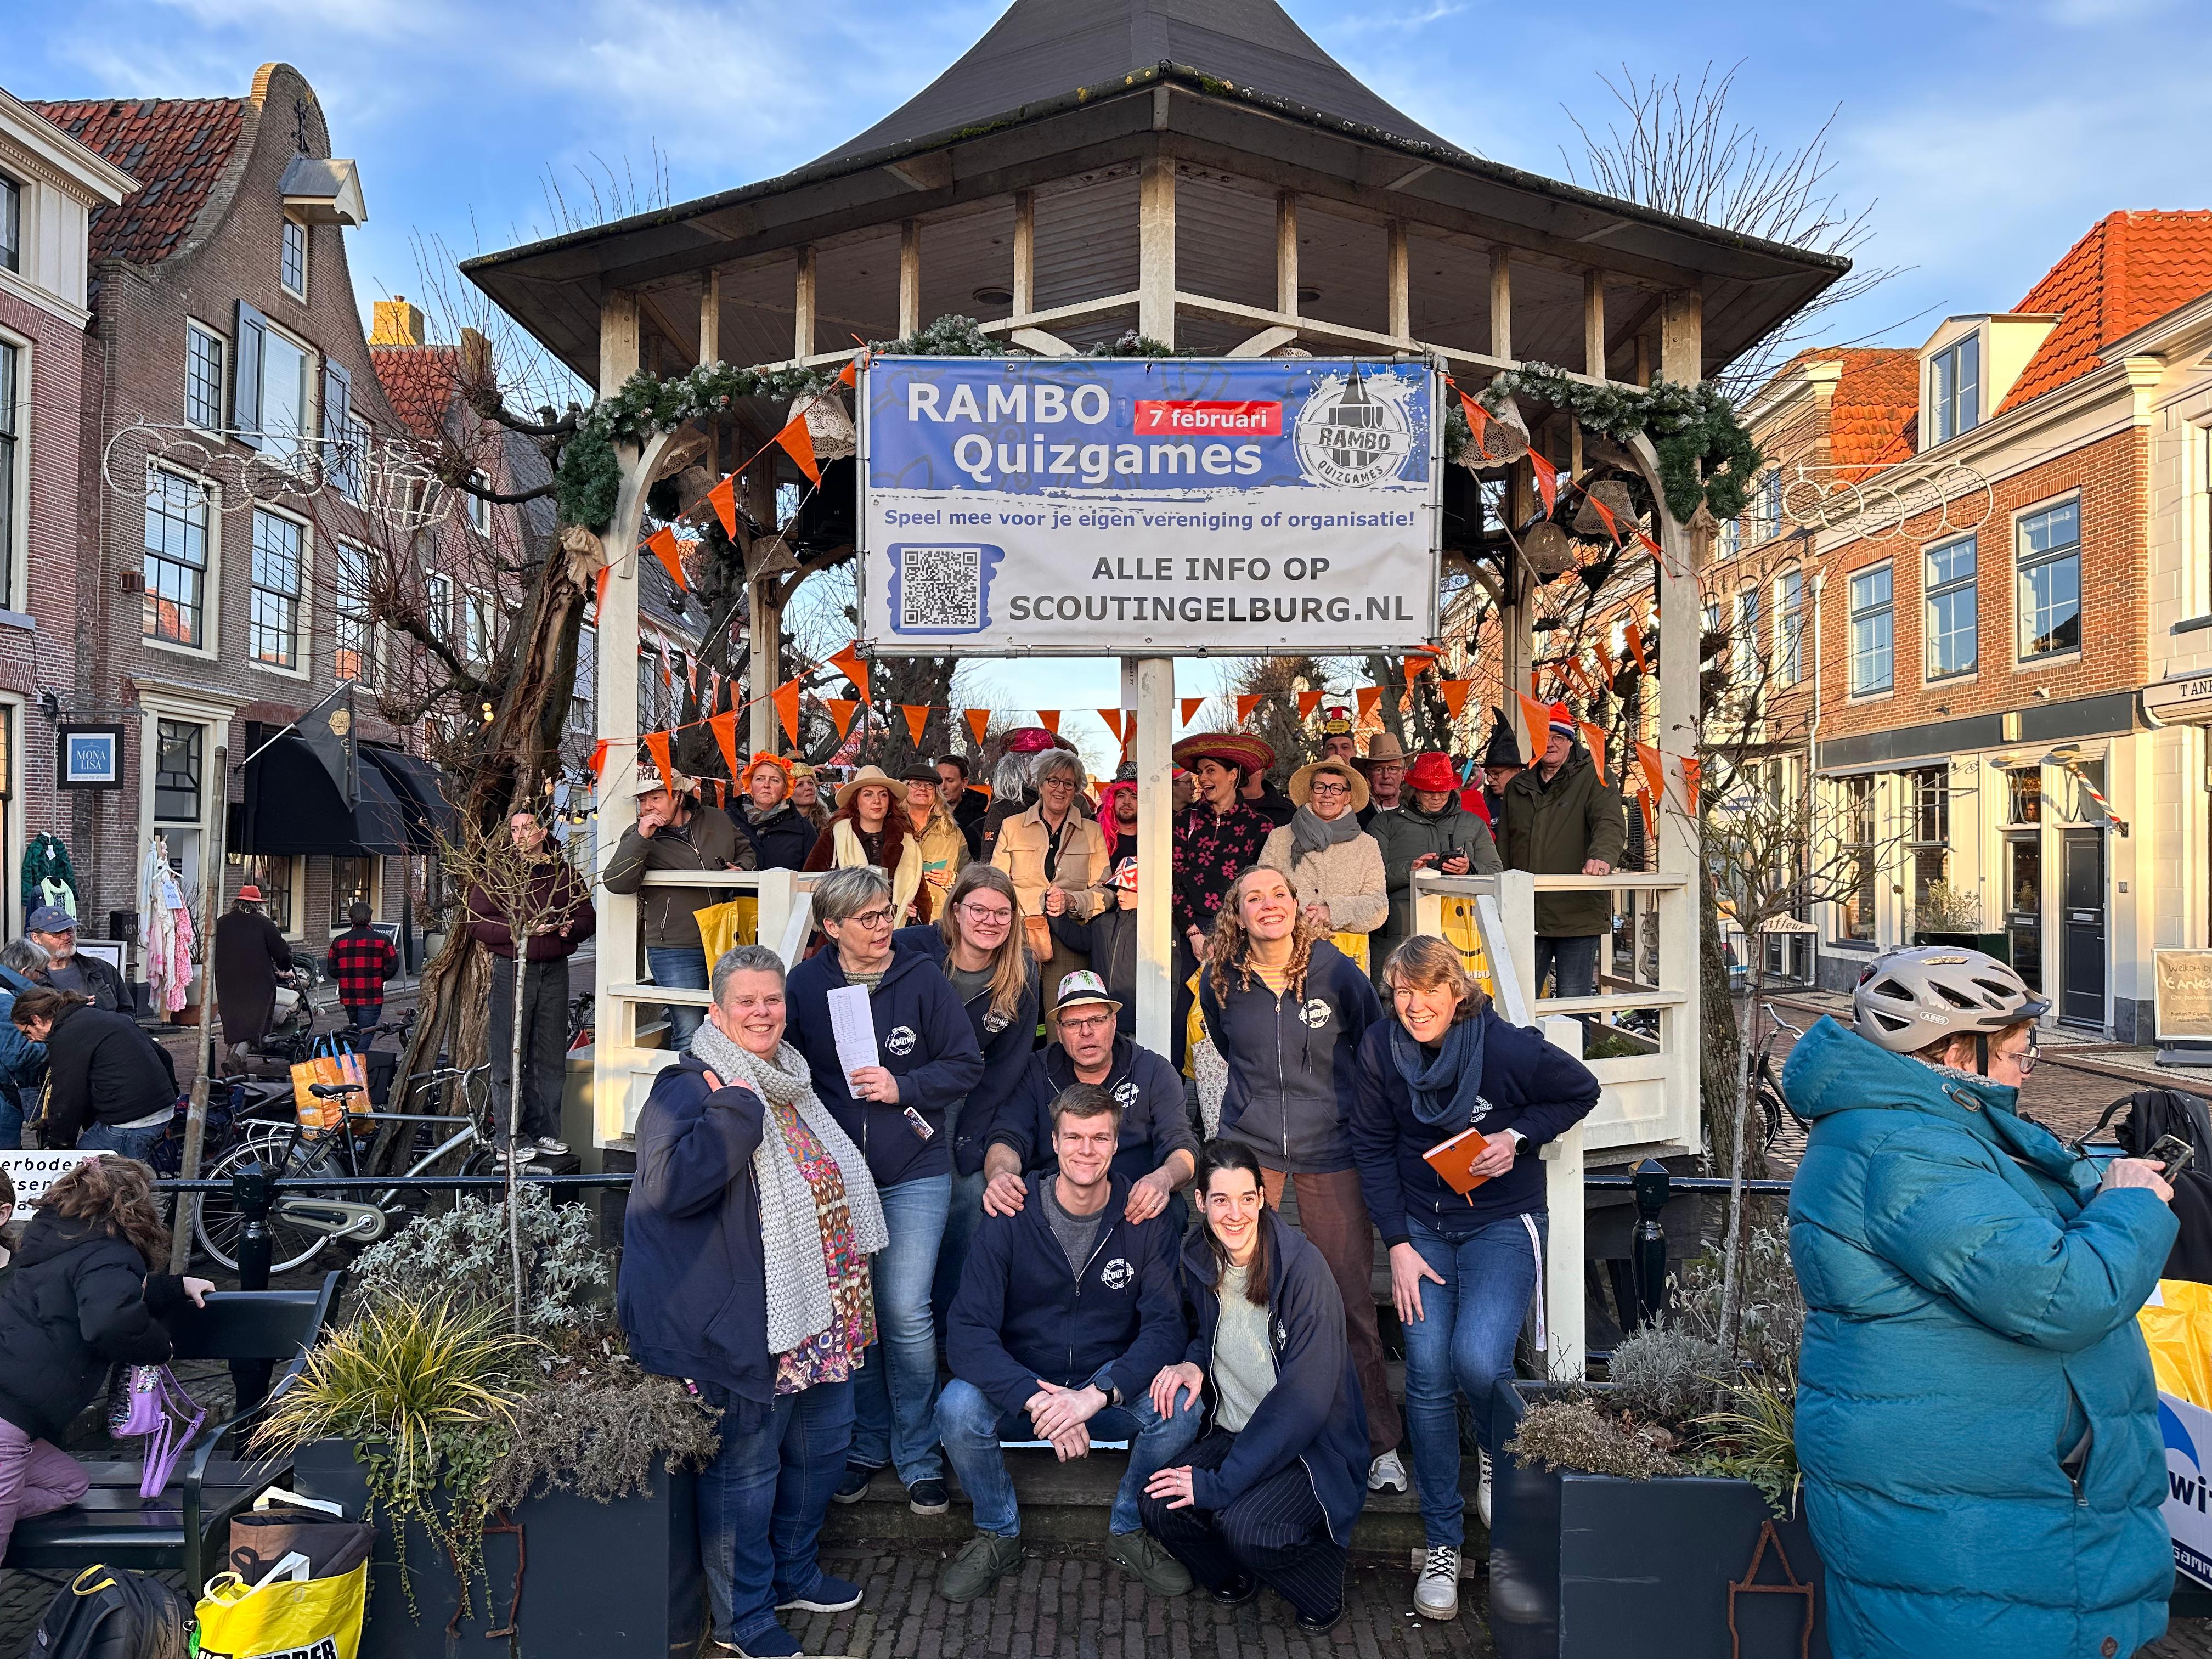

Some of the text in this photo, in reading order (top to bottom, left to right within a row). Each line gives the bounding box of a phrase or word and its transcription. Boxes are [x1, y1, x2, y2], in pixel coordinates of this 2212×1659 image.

[907, 383, 1110, 424] RAMBO
[1149, 408, 1267, 428] 7 februari
[1319, 427, 1391, 450] RAMBO
[953, 433, 1262, 483] Quizgames
[1318, 460, 1384, 483] QUIZGAMES
[885, 509, 1414, 531] Speel mee voor je eigen vereniging of organisatie!
[1092, 557, 1330, 580] ALLE INFO OP
[1009, 595, 1414, 622] SCOUTINGELBURG.NL
[77, 751, 106, 760] MONA
[81, 760, 102, 770] LISA
[1763, 917, 1805, 931] oiffeur
[2177, 977, 2212, 990] Anke
[1923, 1013, 1946, 1023] ABUS
[2168, 1470, 2212, 1514] wi
